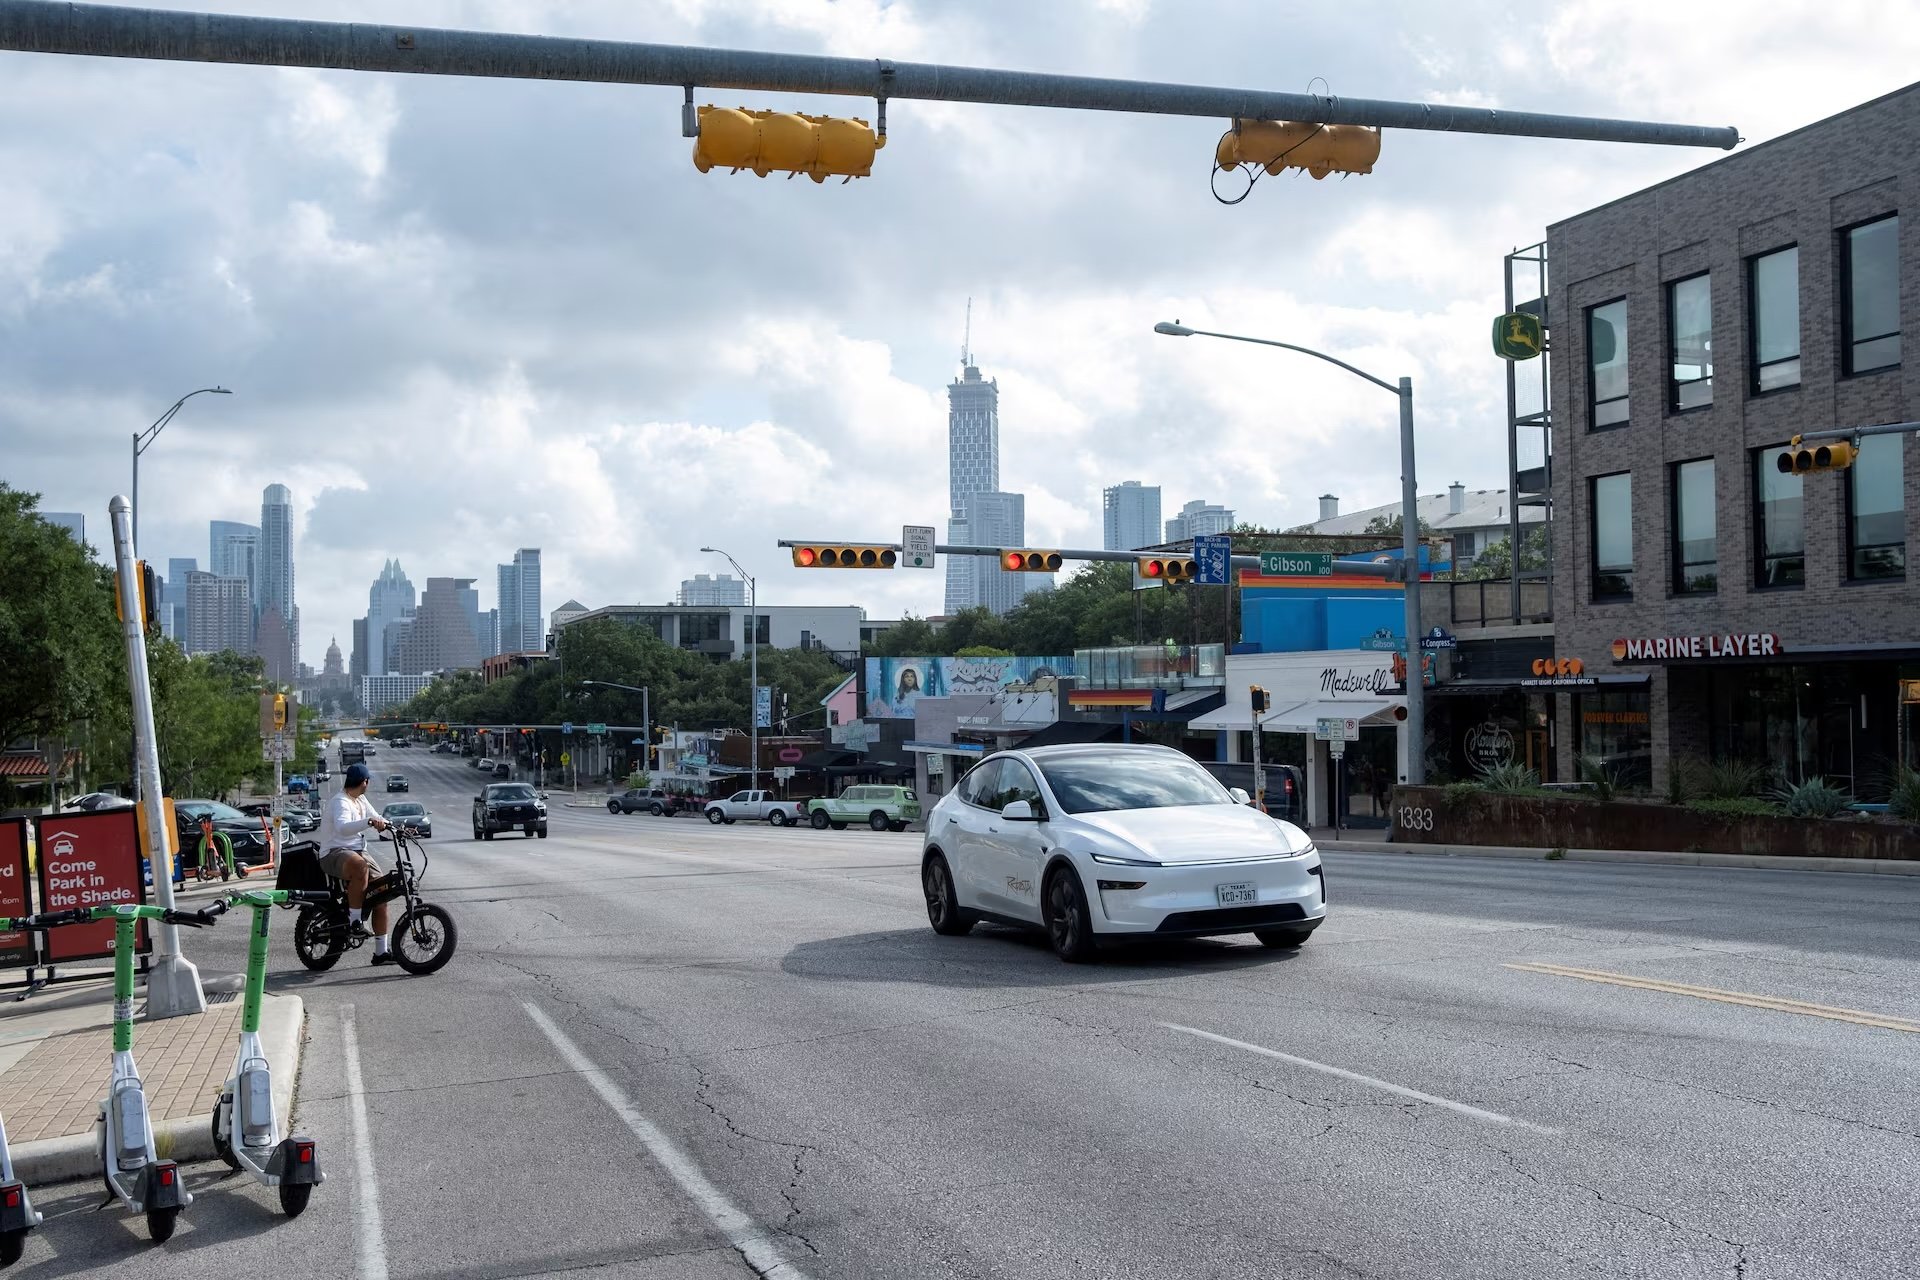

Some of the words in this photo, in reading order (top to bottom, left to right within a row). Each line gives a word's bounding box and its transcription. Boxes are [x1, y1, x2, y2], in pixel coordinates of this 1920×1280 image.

[910, 543, 928, 551] YIELD
[1261, 559, 1267, 568] E
[1269, 556, 1312, 572] Gibson
[1321, 555, 1331, 563] ST
[1318, 566, 1331, 575] 100
[1372, 640, 1396, 649] Gibson
[1426, 639, 1451, 649] Congress
[1627, 636, 1701, 660] MARINE
[1708, 633, 1776, 657] LAYER
[1320, 668, 1388, 698] Madewell
[1552, 678, 1576, 686] CALIFORNIA
[1398, 806, 1434, 831] 1333
[49, 860, 96, 874] Come
[50, 875, 86, 890] Park
[90, 874, 105, 886] in
[2, 897, 20, 905] 6pm
[50, 893, 77, 907] the
[81, 886, 136, 904] Shade.
